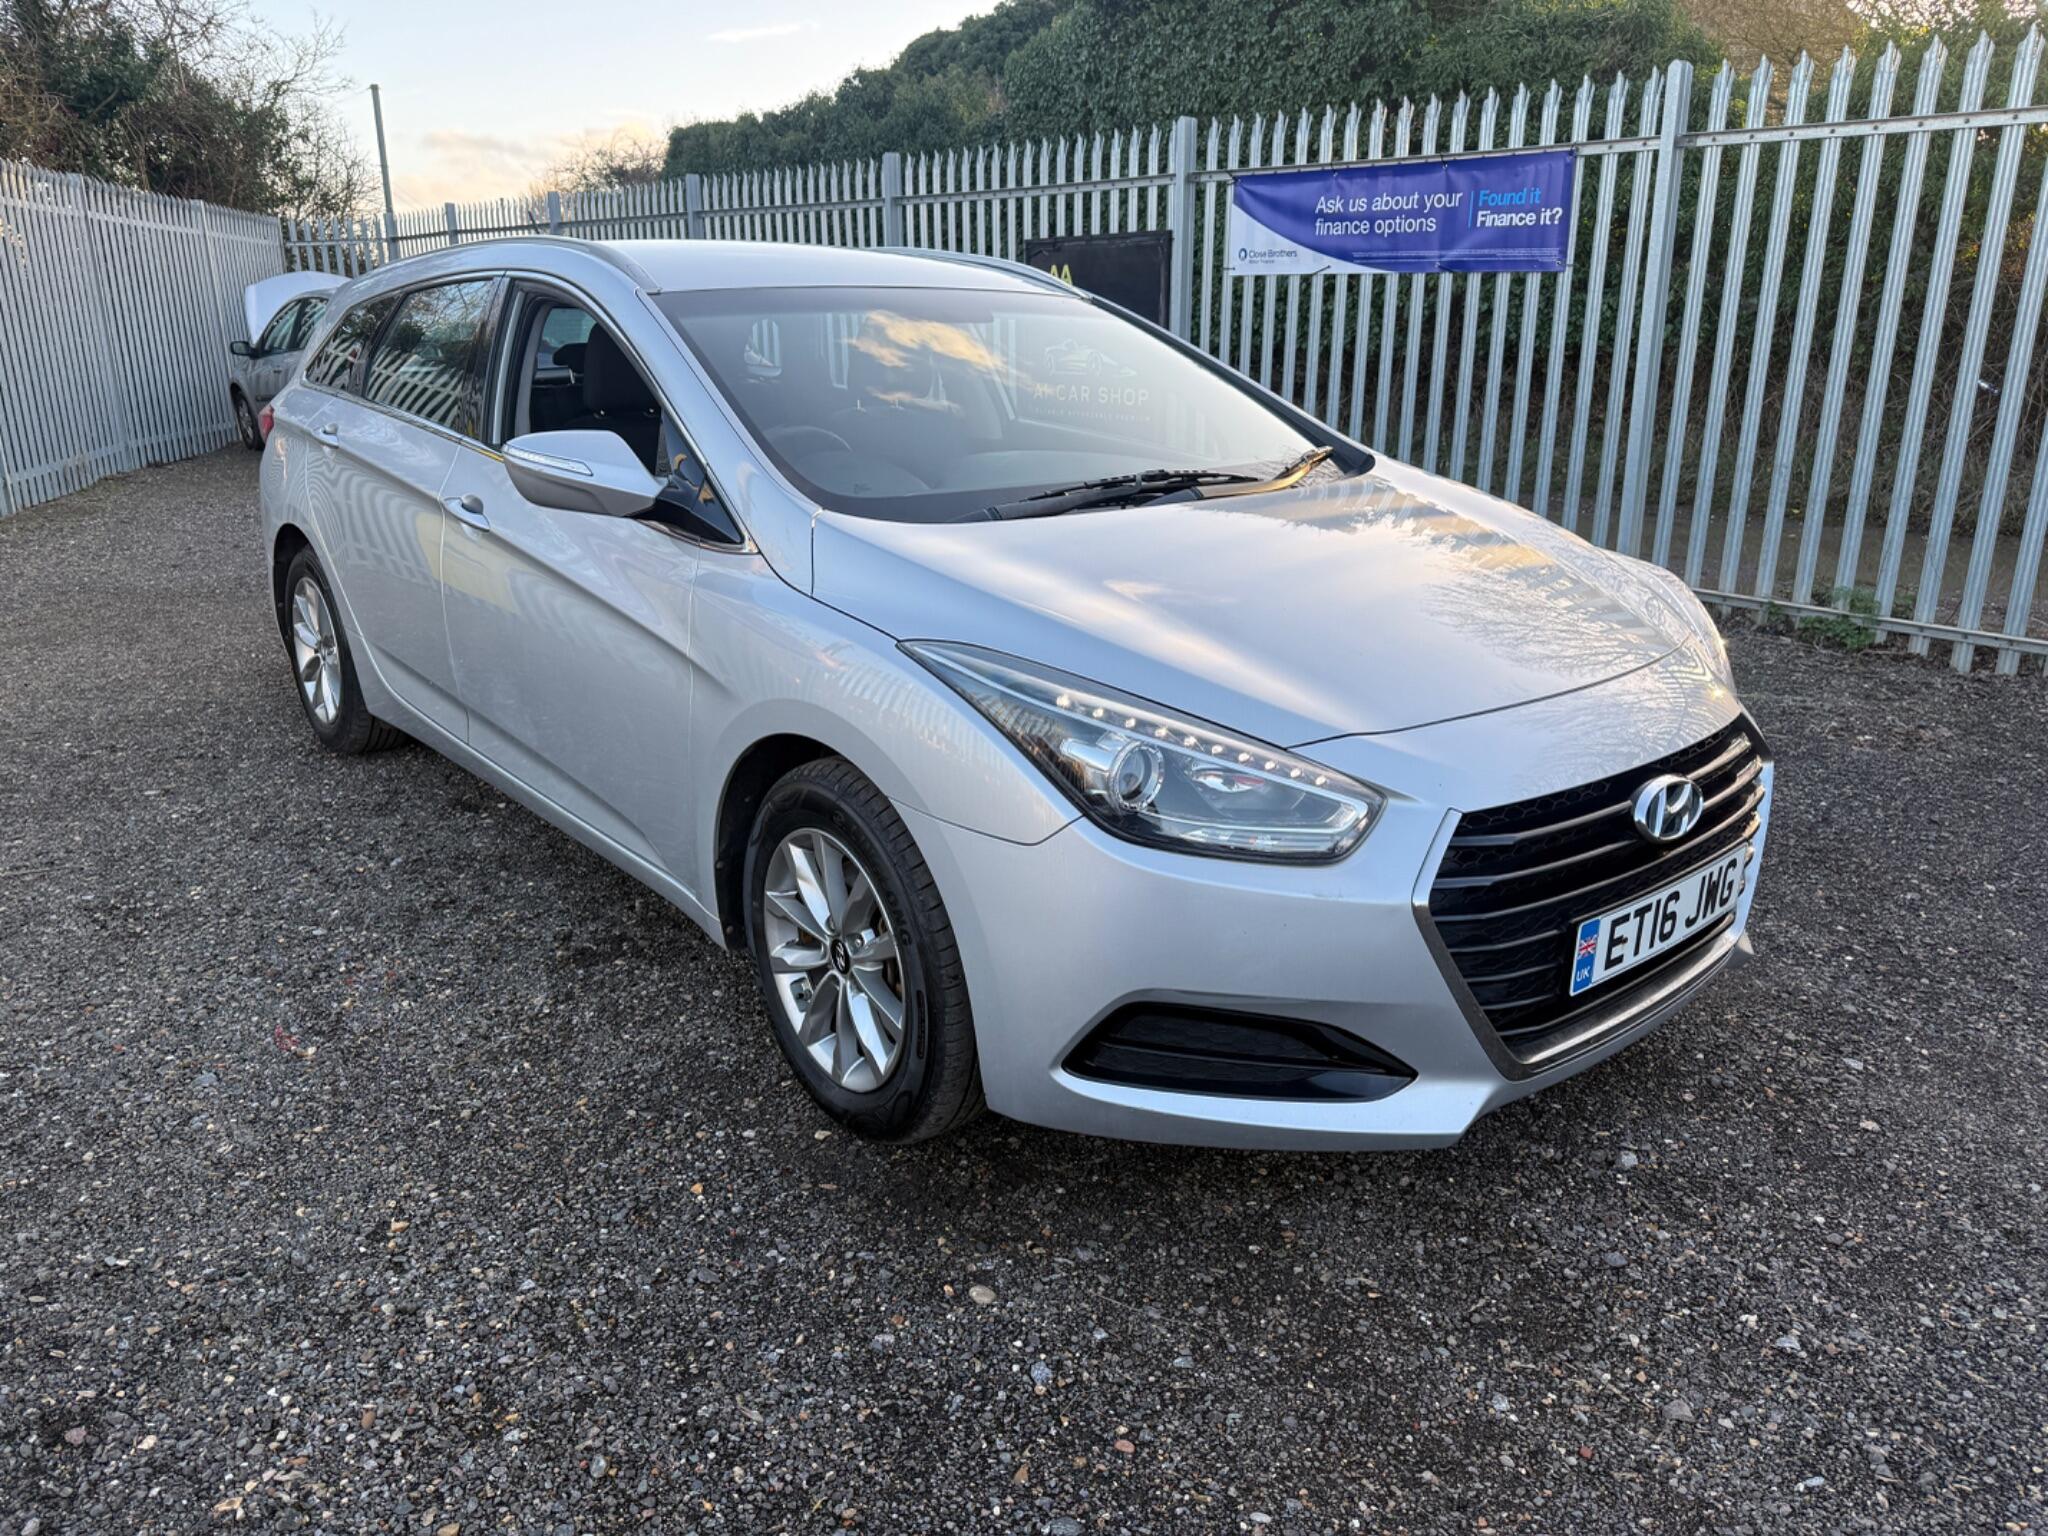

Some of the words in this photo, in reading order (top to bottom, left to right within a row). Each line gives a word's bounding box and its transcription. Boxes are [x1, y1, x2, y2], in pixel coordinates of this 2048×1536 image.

[1315, 196, 1344, 213] Ask
[1349, 196, 1367, 212] us
[1371, 192, 1418, 211] about
[1424, 192, 1463, 213] your
[1479, 188, 1527, 207] Found
[1530, 187, 1541, 204] it
[1315, 218, 1370, 235] finance
[1374, 214, 1436, 237] options
[1476, 210, 1536, 227] Finance
[1540, 207, 1563, 225] it?
[1268, 249, 1297, 258] Brothers
[1056, 384, 1089, 403] CAR
[1098, 386, 1149, 406] SHOP
[1604, 890, 1680, 971] ET16
[1685, 858, 1737, 928] JWG
[1576, 966, 1591, 982] UK
